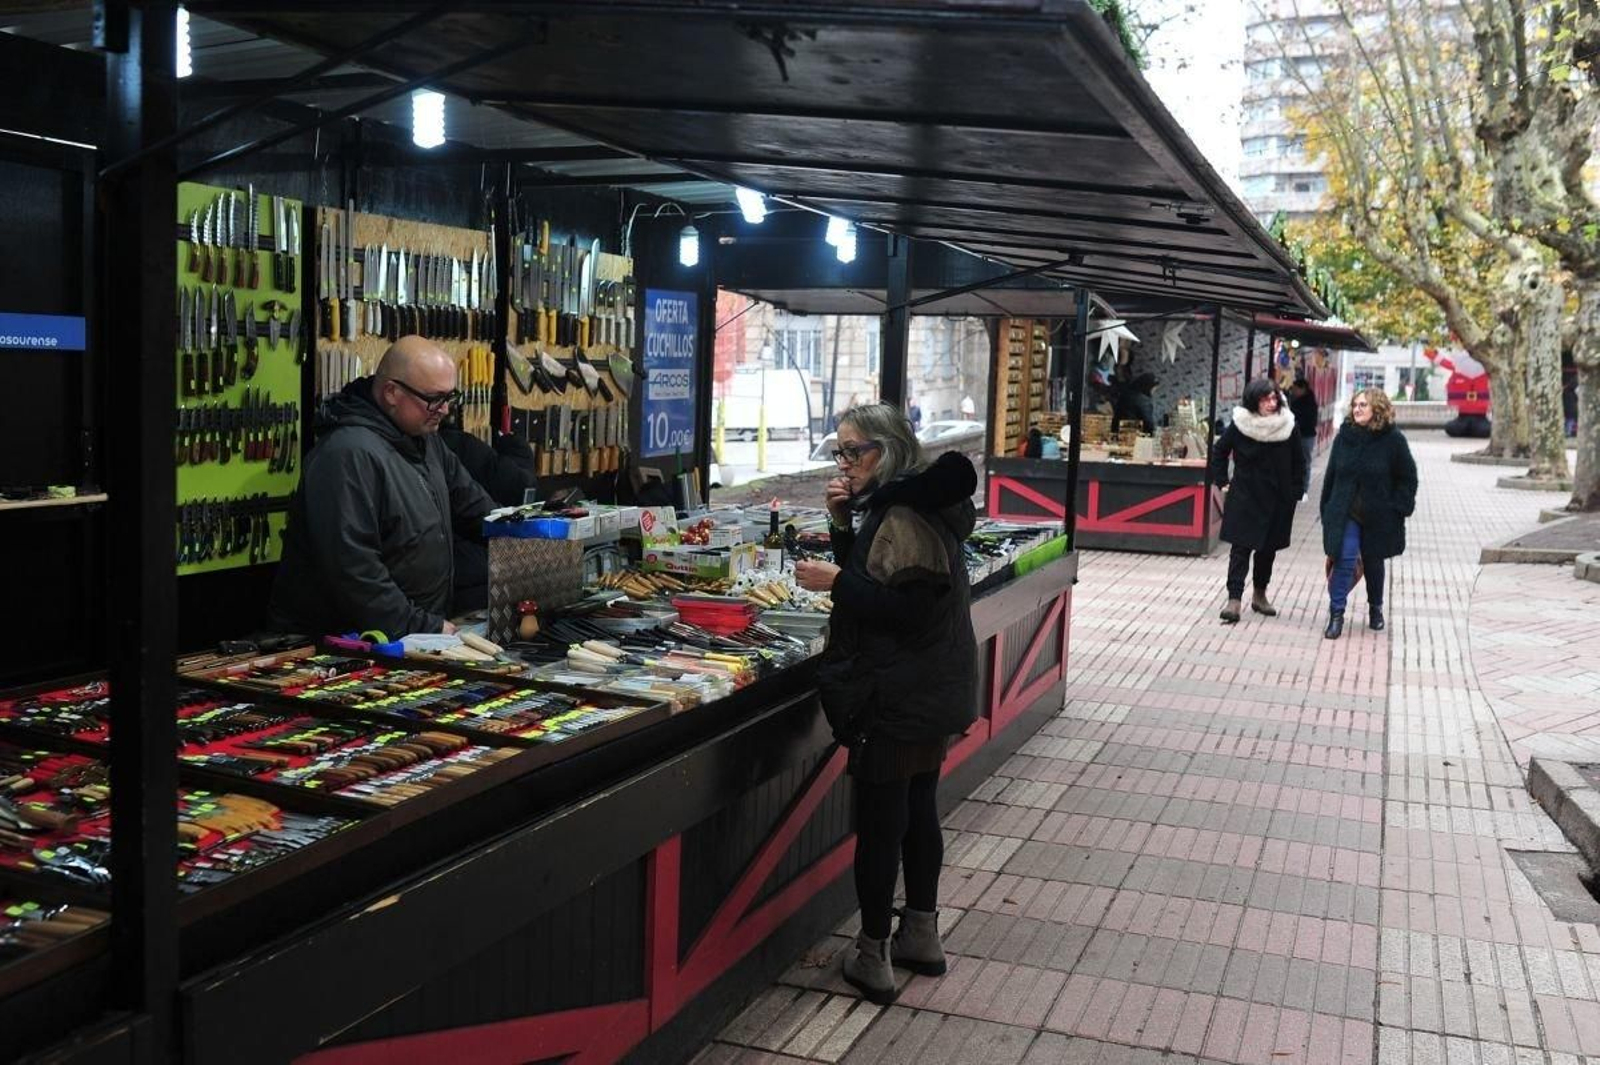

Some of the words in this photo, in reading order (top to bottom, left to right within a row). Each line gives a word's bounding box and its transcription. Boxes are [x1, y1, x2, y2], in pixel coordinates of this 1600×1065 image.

[655, 298, 688, 325] OFERTA
[647, 333, 694, 358] CUCHILLOS
[649, 372, 689, 388] ARCOS
